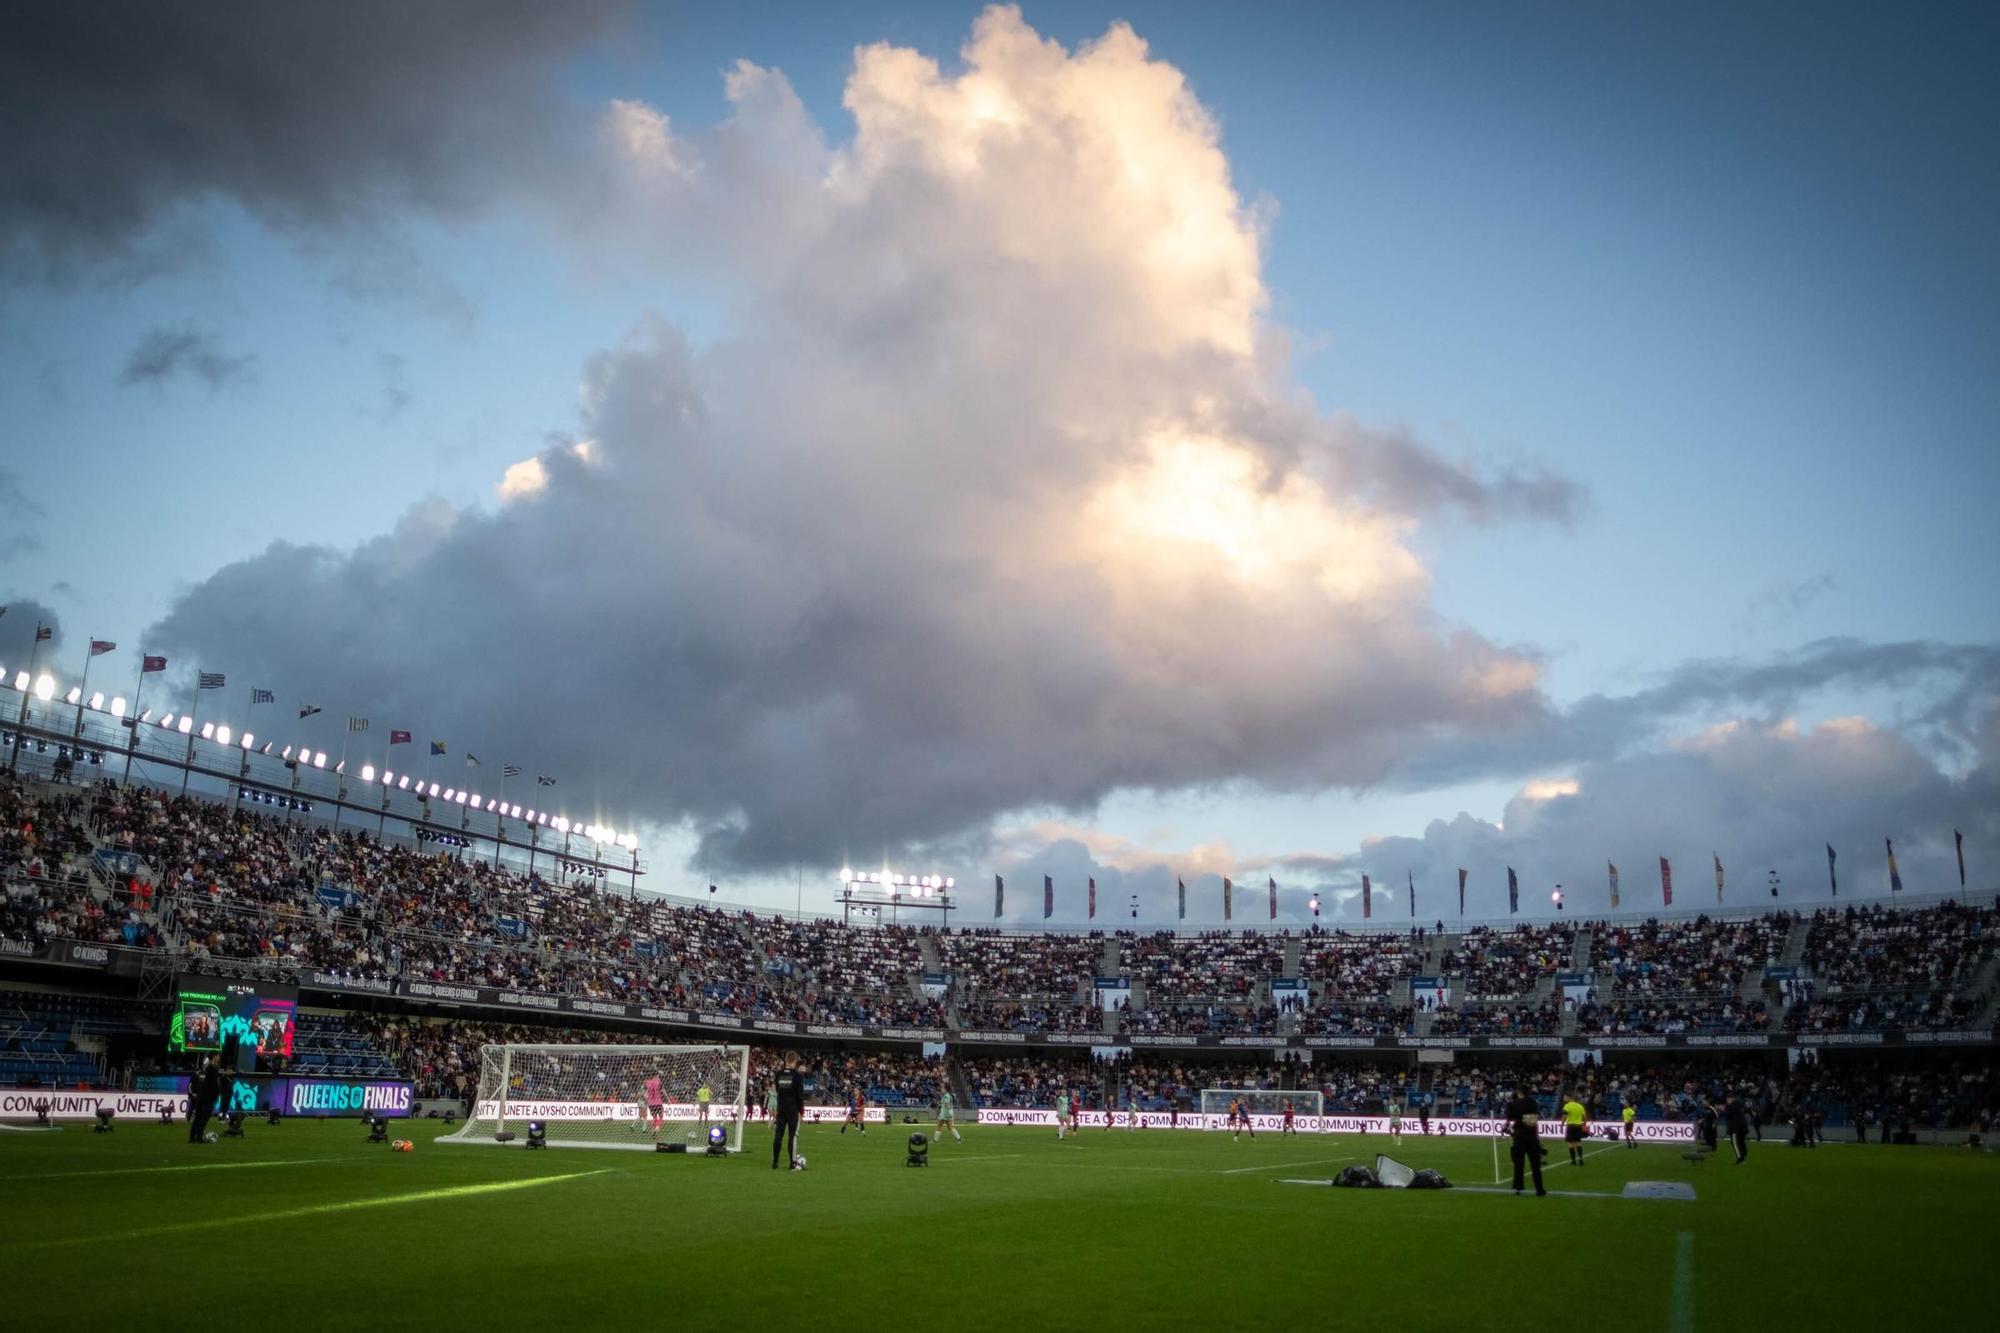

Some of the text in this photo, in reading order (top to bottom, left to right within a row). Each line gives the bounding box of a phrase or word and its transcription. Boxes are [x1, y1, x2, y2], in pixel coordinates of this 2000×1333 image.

[1, 938, 35, 955] FINALS
[80, 947, 108, 961] KINGS
[415, 984, 479, 1000] KINGS QUEENS FINALS
[504, 994, 559, 1008] KINGS QUEENS FINALS
[3, 1096, 104, 1112] COMMUNITY
[117, 1095, 164, 1113] ÚNETE
[293, 1084, 410, 1112] QUEENS FINALS
[532, 1106, 539, 1116] A
[540, 1106, 567, 1116] OYSHO
[568, 1106, 614, 1116] COMMUNITY
[987, 1112, 1048, 1122] COMMUNITY
[1257, 1119, 1266, 1128] A
[1310, 1119, 1383, 1130] COMMUNITY
[1448, 1122, 1491, 1133] OYSHO
[1634, 1126, 1644, 1136] A
[1647, 1126, 1694, 1138] OYSHO
